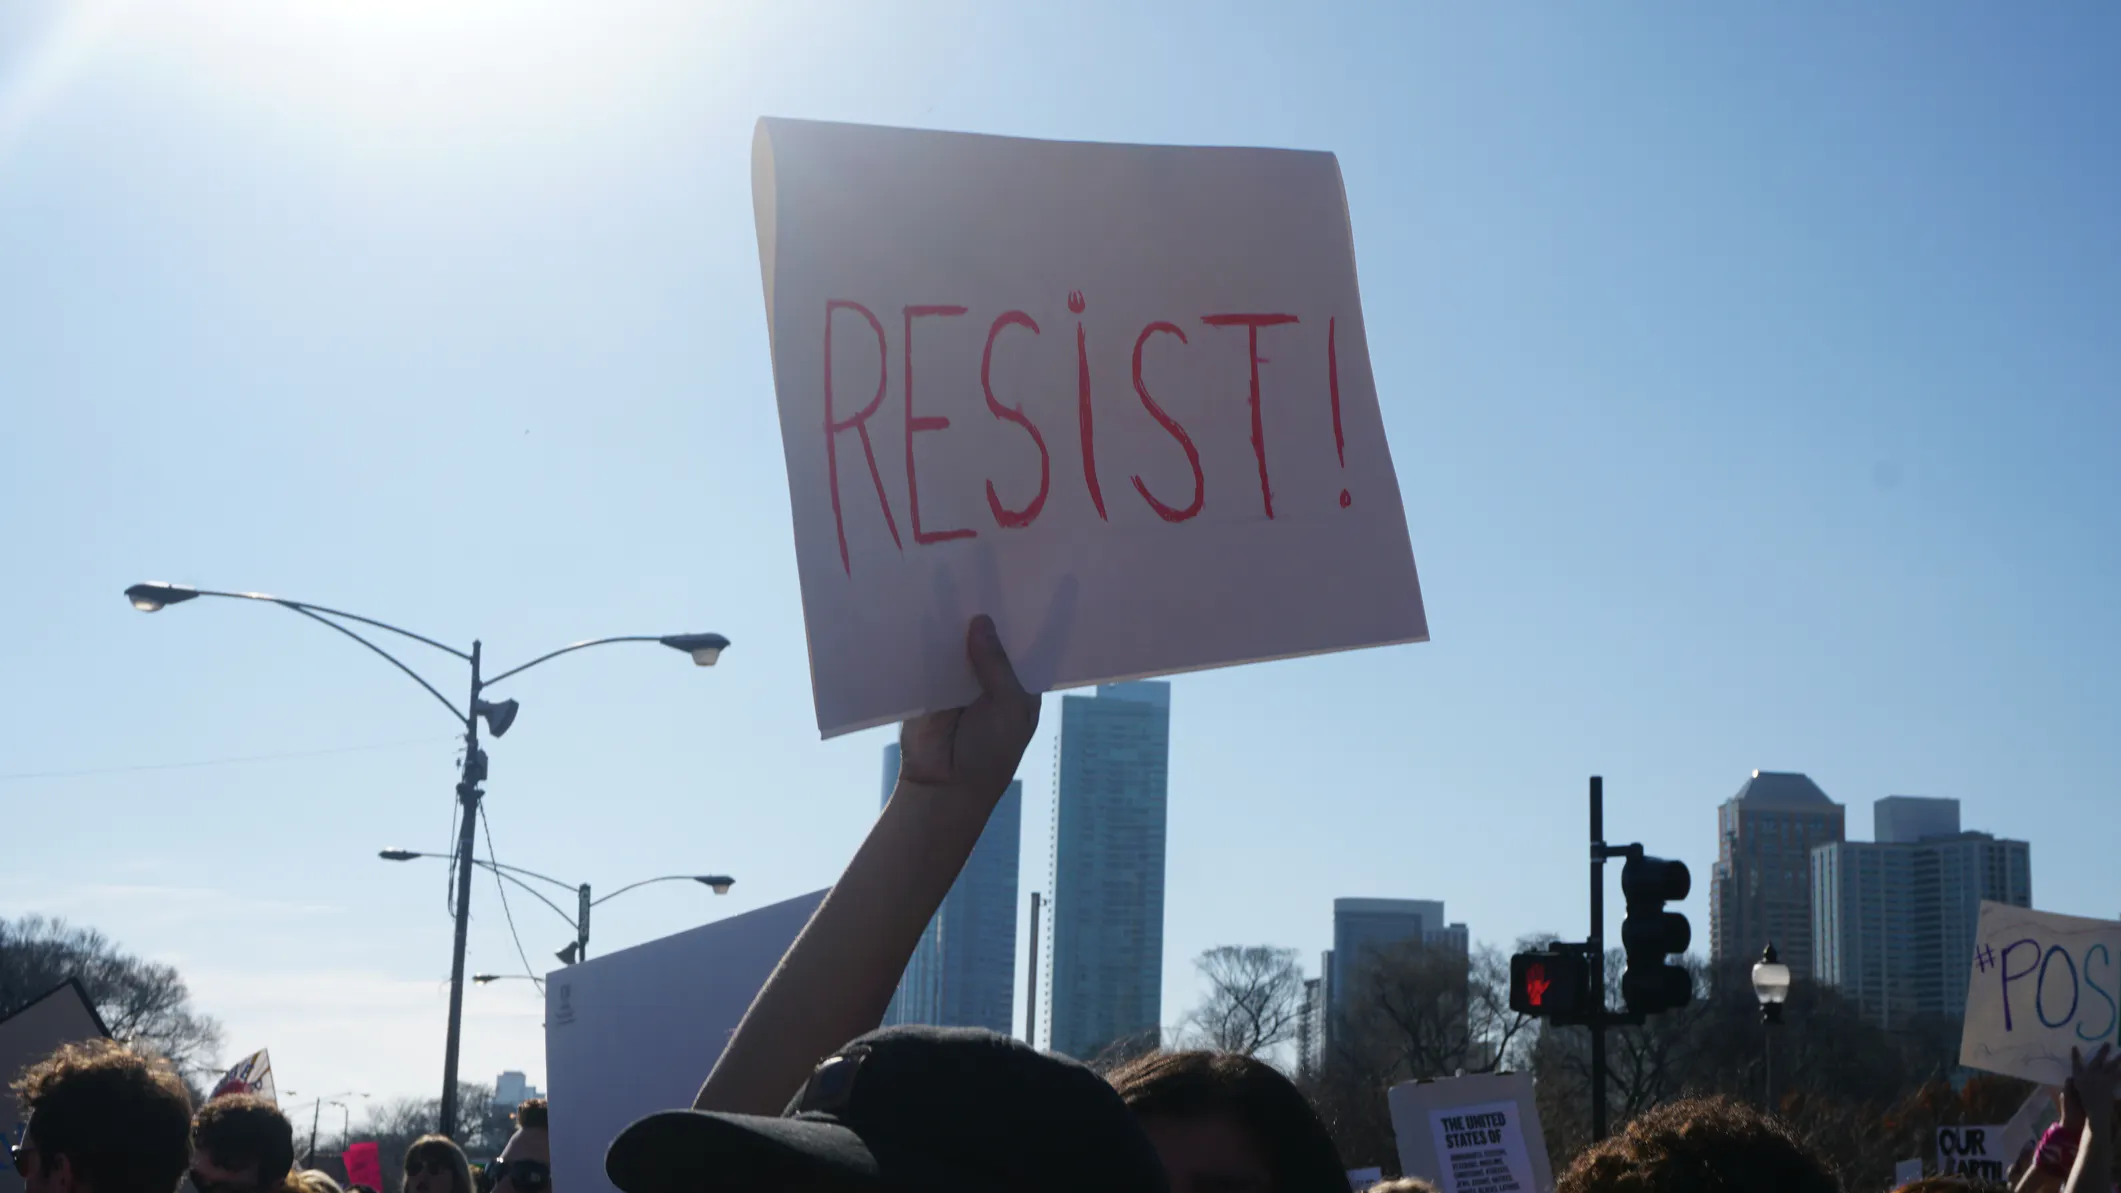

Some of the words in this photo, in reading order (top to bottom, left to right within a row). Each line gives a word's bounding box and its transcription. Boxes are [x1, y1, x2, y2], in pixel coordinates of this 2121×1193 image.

[823, 288, 1351, 580] RESIST!
[1974, 938, 2121, 1048] #POS
[1440, 1116, 1465, 1132] THE
[1465, 1111, 1506, 1129] UNITED
[1445, 1131, 1487, 1149] STATES
[1487, 1129, 1502, 1144] OF
[1939, 1128, 1986, 1156] OUR
